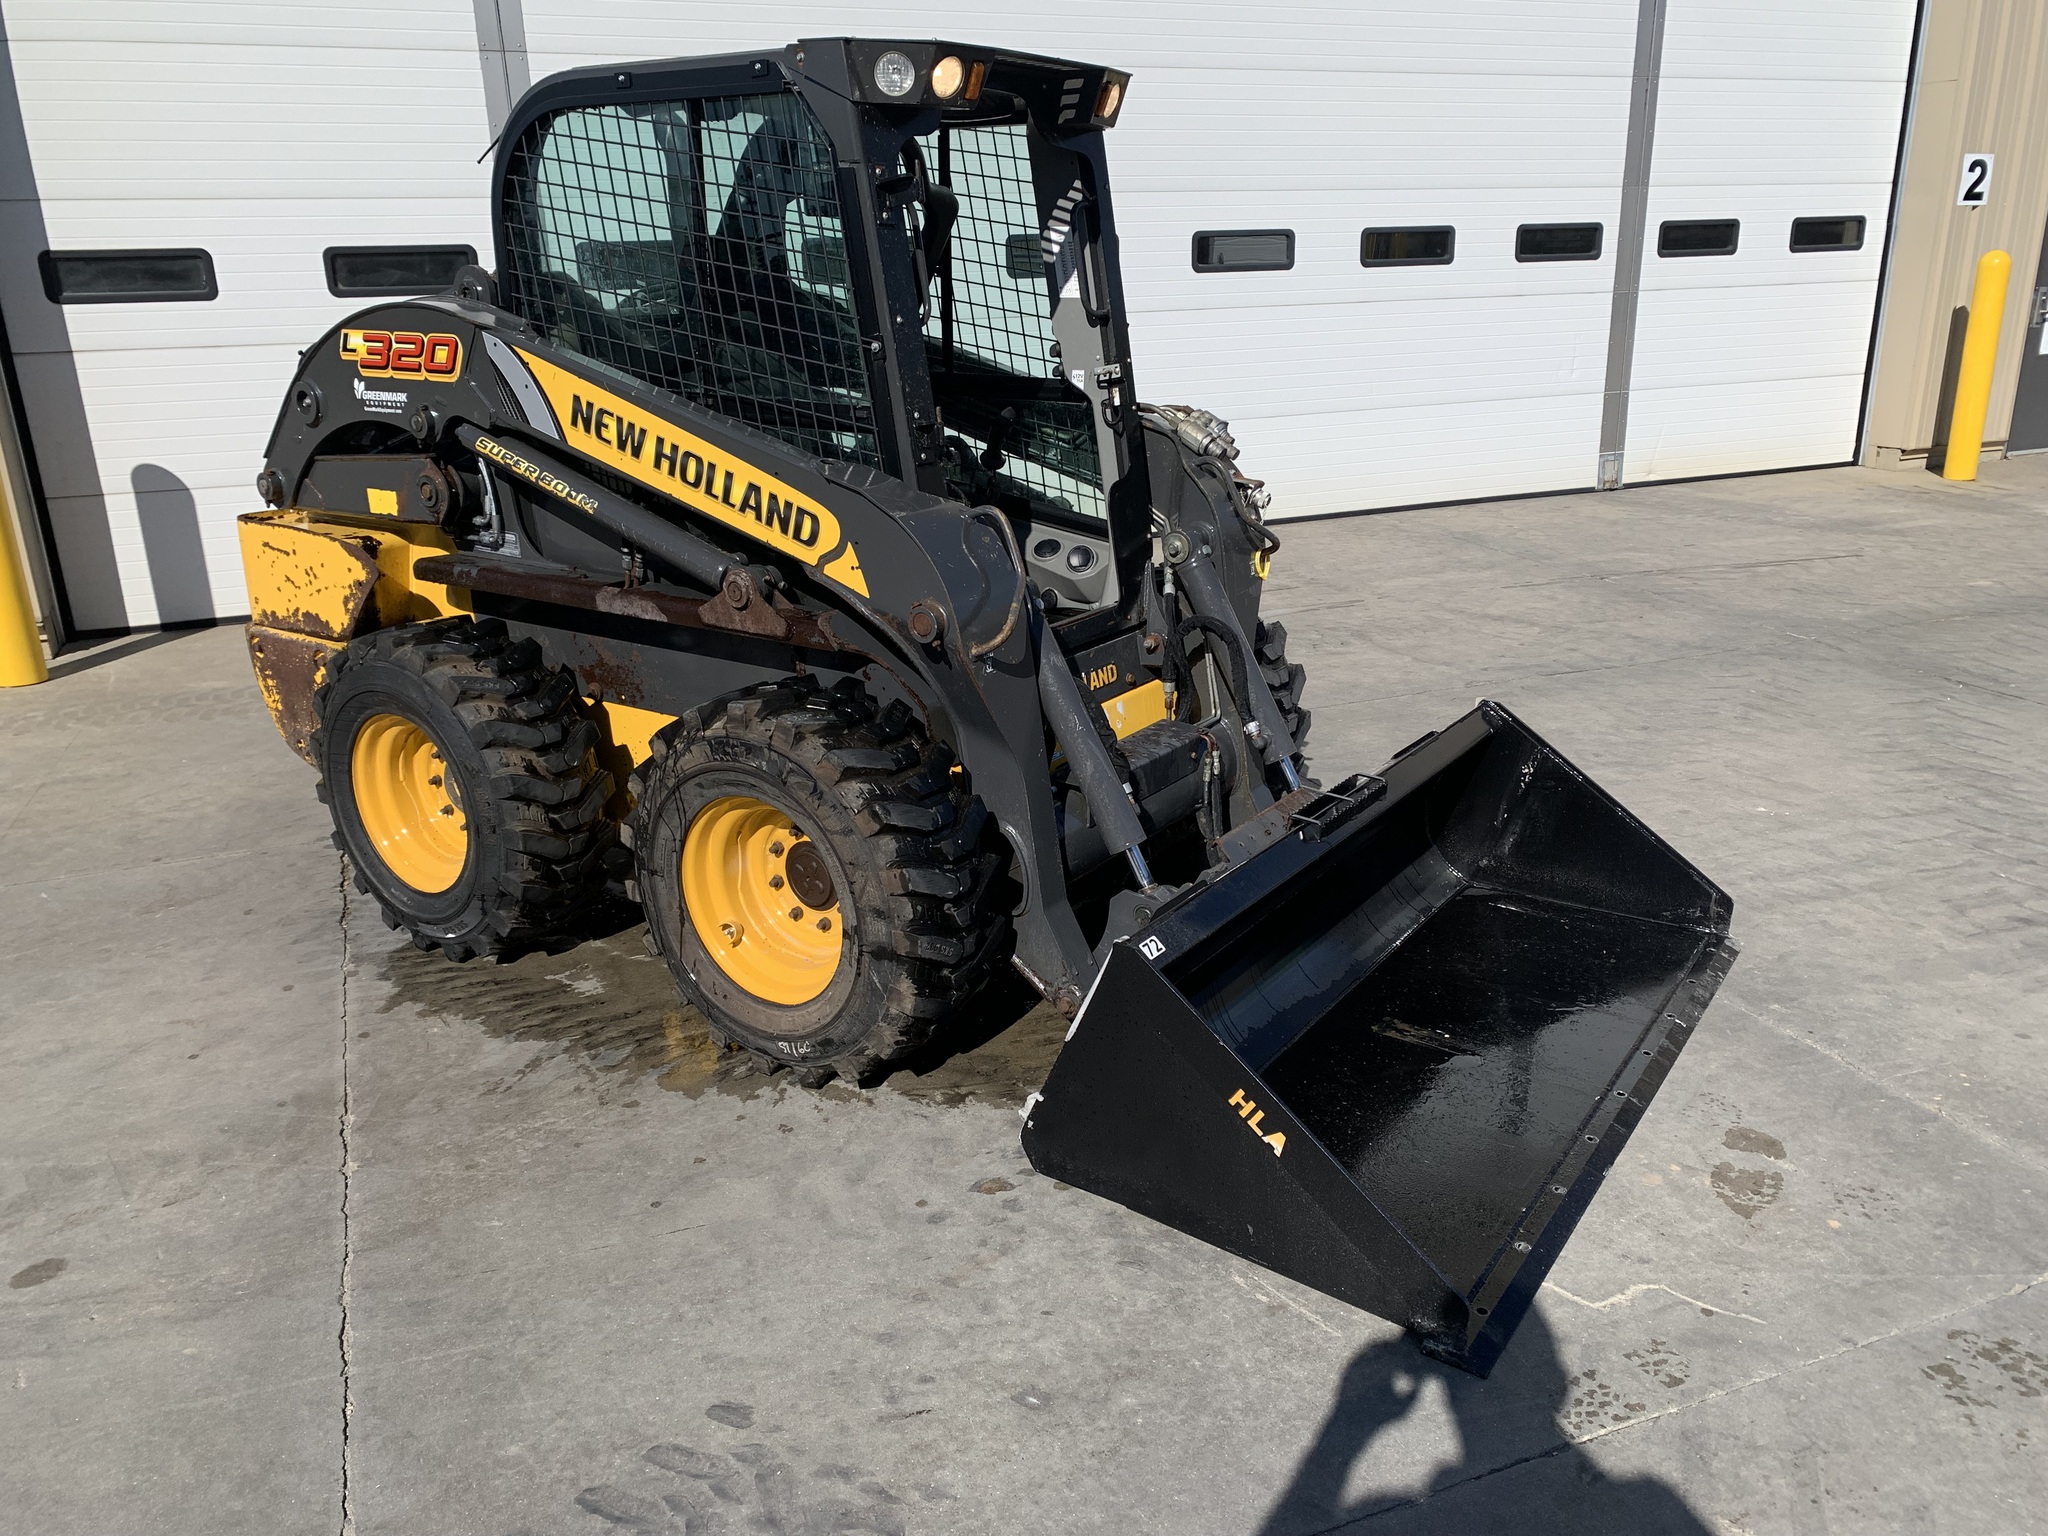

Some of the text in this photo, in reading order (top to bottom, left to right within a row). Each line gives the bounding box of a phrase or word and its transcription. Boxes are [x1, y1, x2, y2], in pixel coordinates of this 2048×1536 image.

[1962, 158, 1989, 201] 2
[341, 331, 460, 378] L320
[362, 391, 407, 402] GREENMARK
[475, 436, 540, 482] SUPER
[569, 393, 821, 549] NEW HOLLAND
[1141, 938, 1163, 957] 72
[1227, 1089, 1287, 1158] HLA
